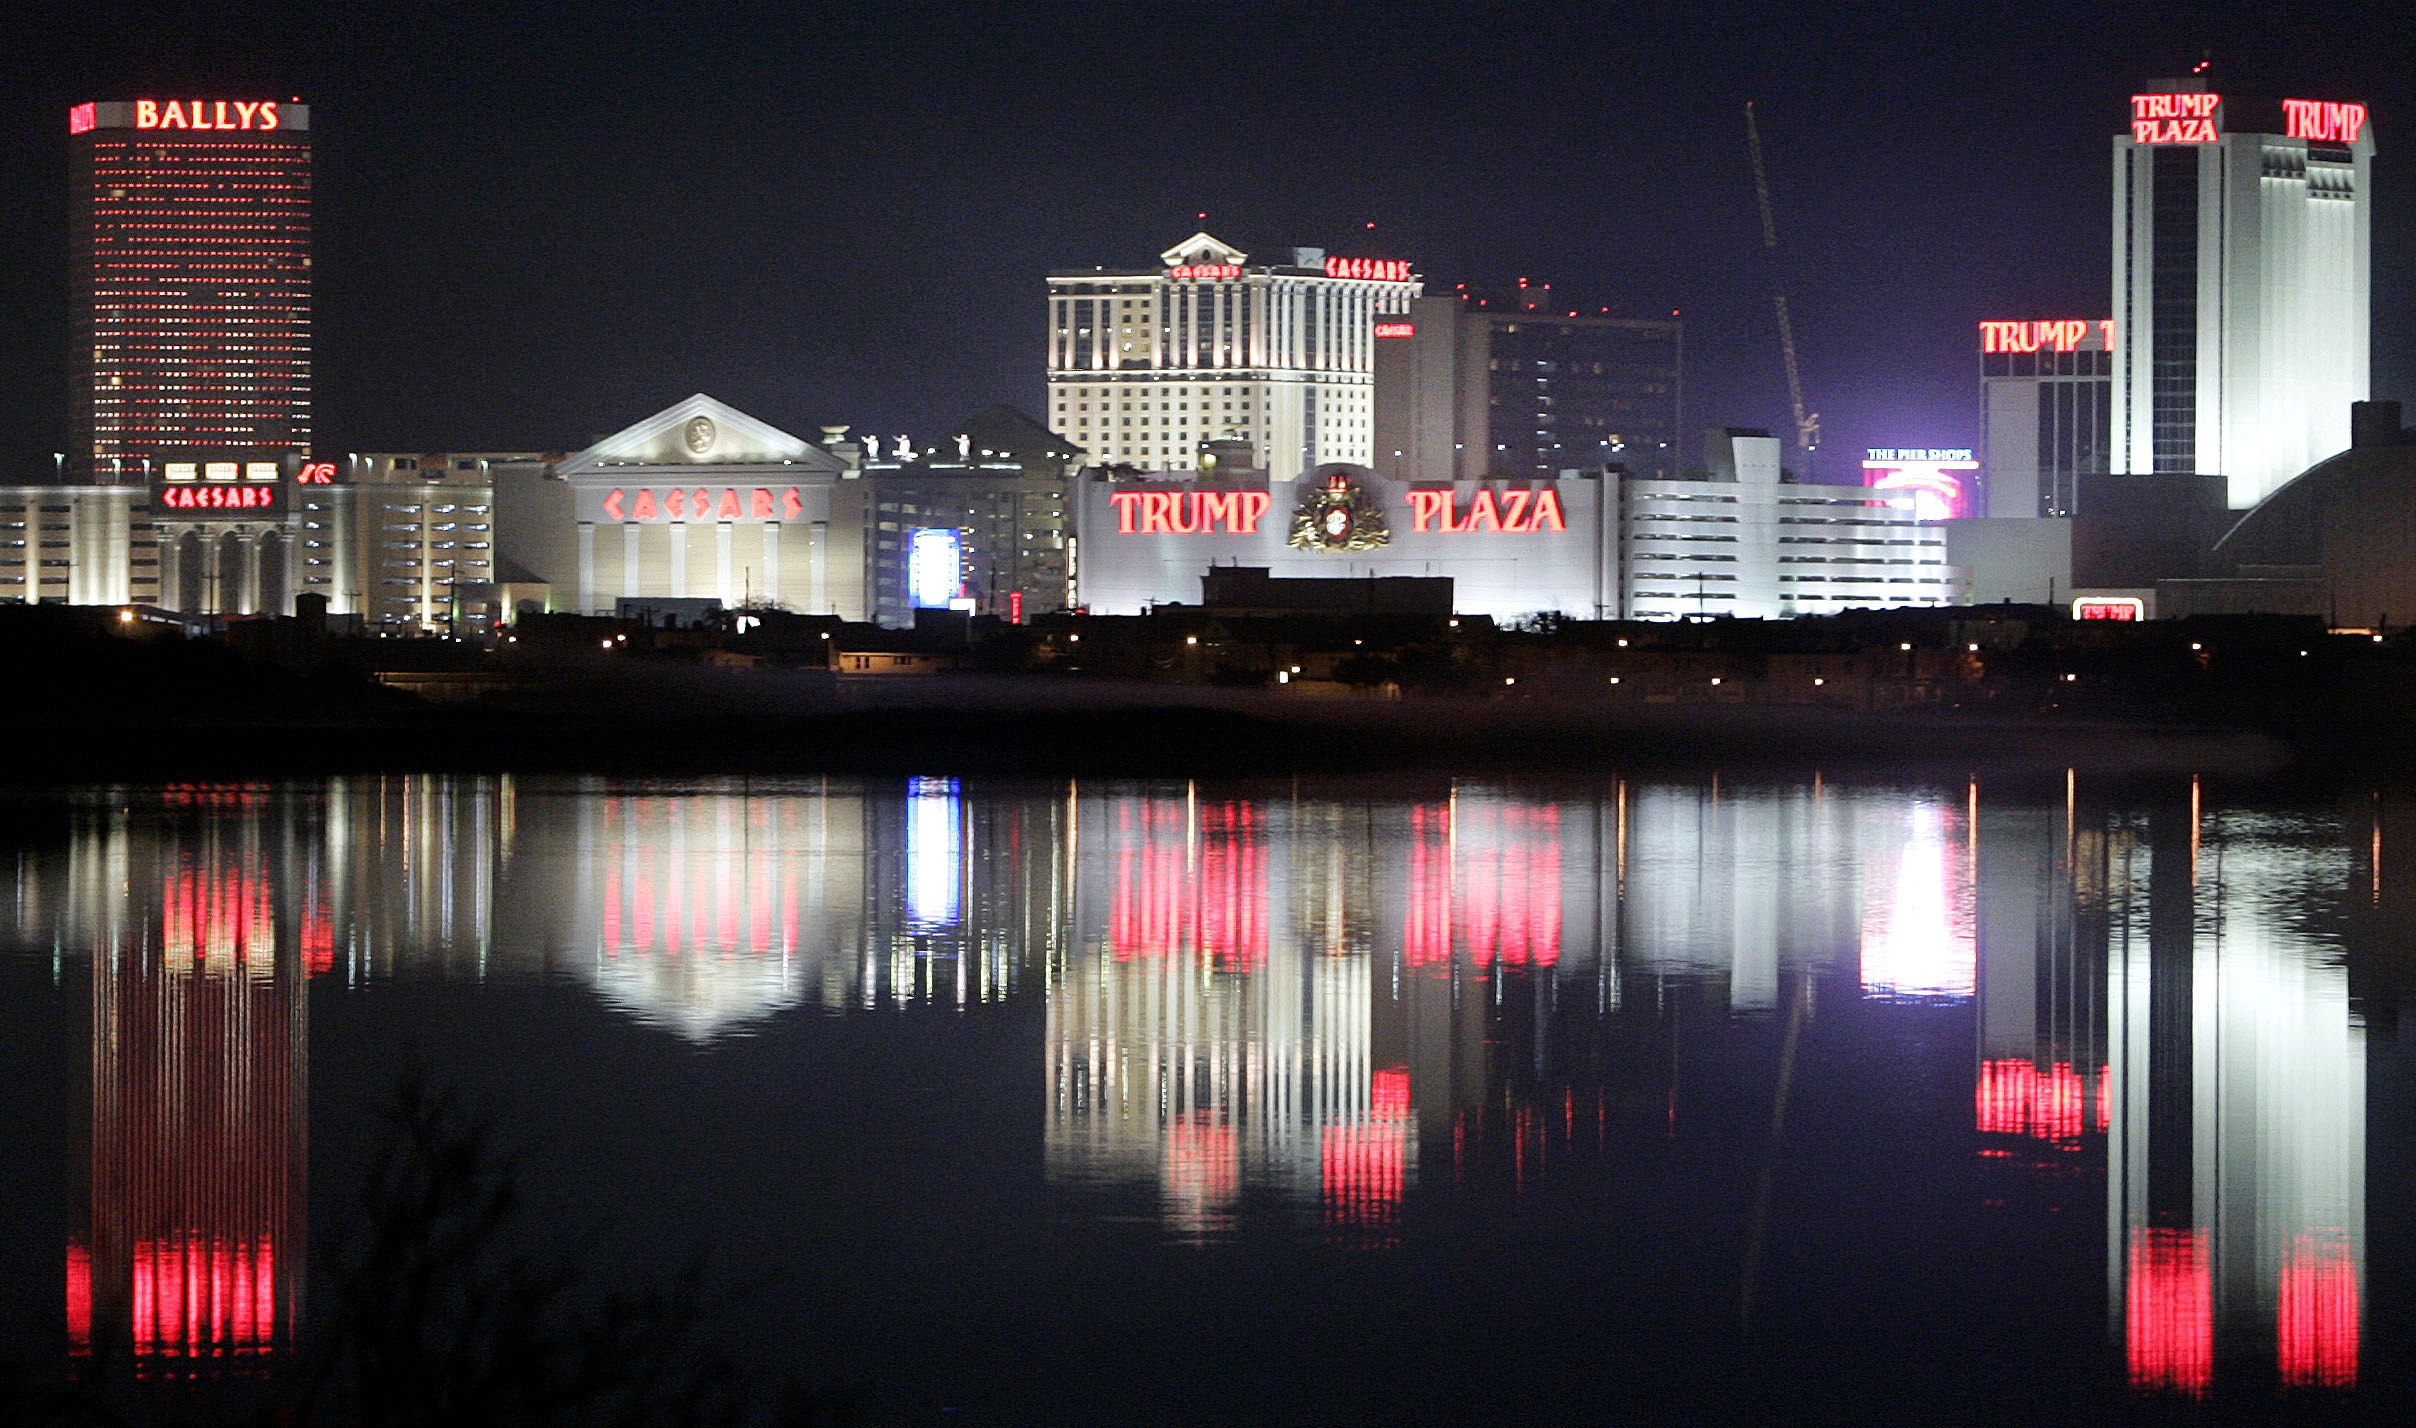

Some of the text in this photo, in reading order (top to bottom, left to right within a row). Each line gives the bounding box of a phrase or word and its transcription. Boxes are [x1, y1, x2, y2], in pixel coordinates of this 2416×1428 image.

[135, 99, 280, 132] BALLYS
[2131, 91, 2221, 118] TRUMP
[2131, 118, 2219, 144] PLAZA
[2282, 98, 2367, 143] TRUMP
[1170, 264, 1242, 279] CAESARS
[1324, 256, 1409, 282] CAESARS
[1978, 319, 2088, 354] TRUMP
[1867, 448, 1896, 460] THE
[162, 485, 273, 508] CAESARS
[603, 487, 802, 520] CAESARS
[1109, 488, 1567, 535] TRUMP PLAZA
